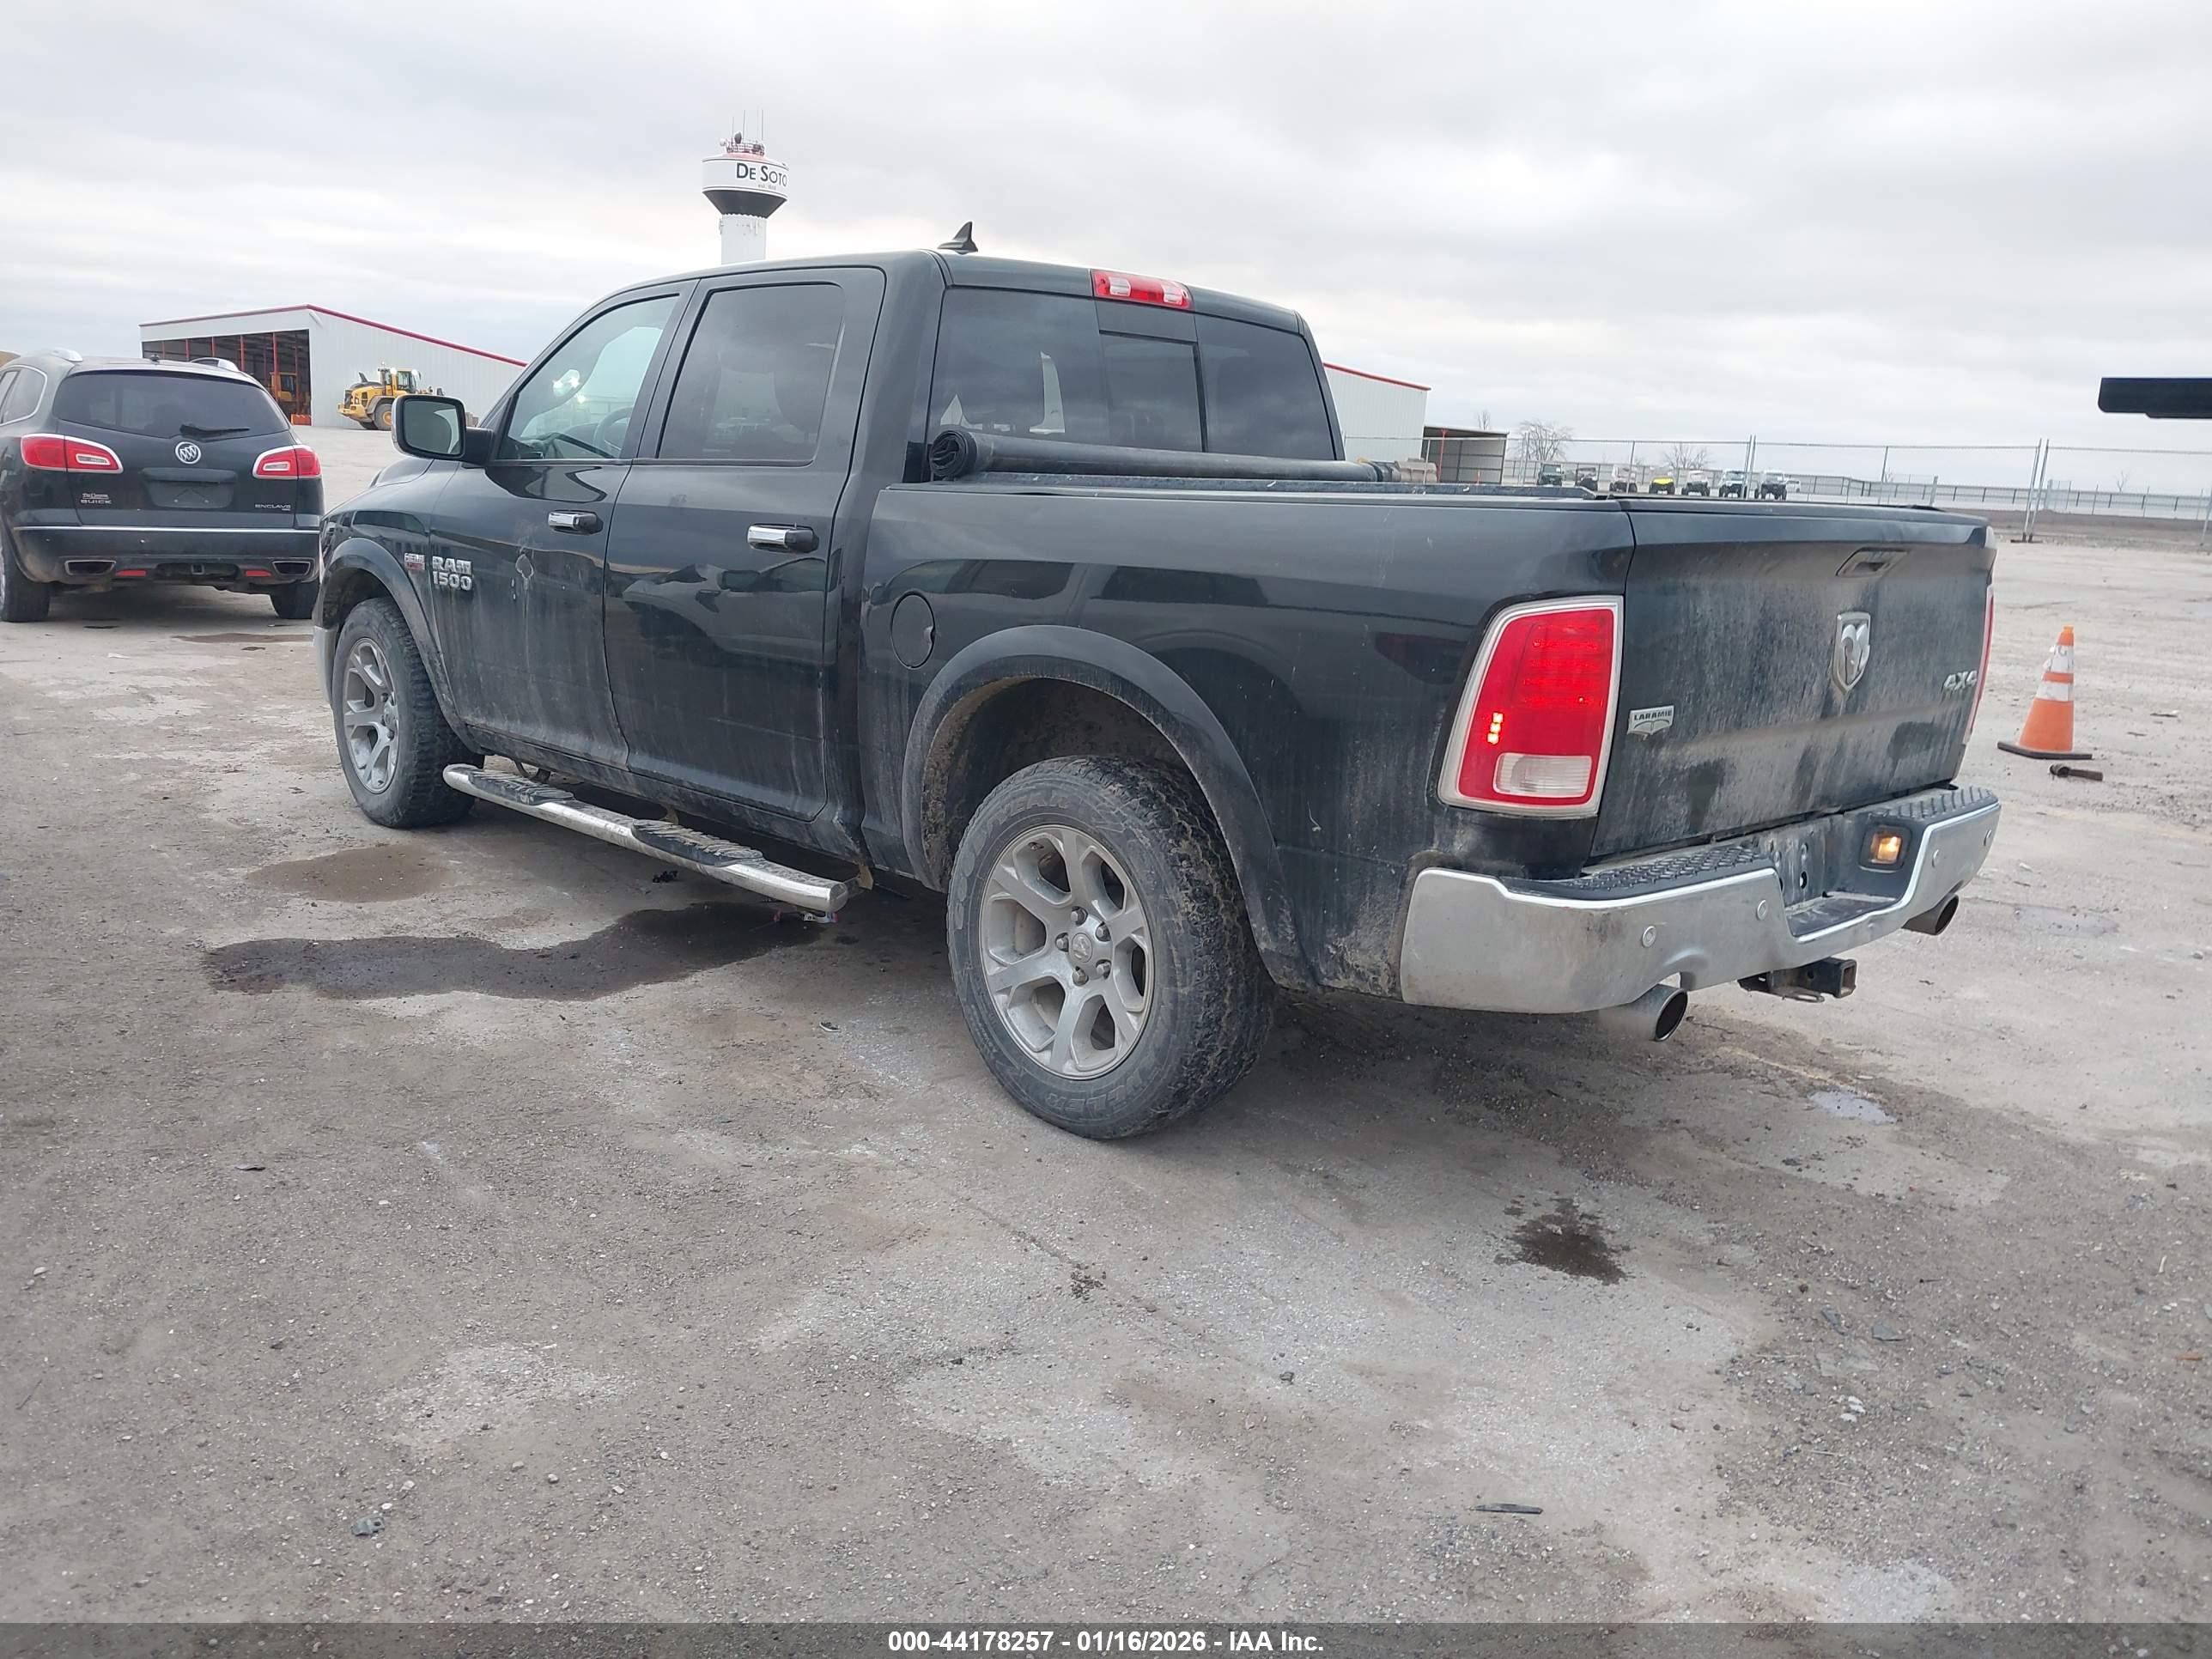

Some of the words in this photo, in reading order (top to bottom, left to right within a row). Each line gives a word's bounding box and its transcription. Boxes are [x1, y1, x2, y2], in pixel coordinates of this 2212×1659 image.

[432, 556, 471, 574] RAM
[432, 570, 472, 592] 1500
[1634, 709, 1672, 721] LARAMIE
